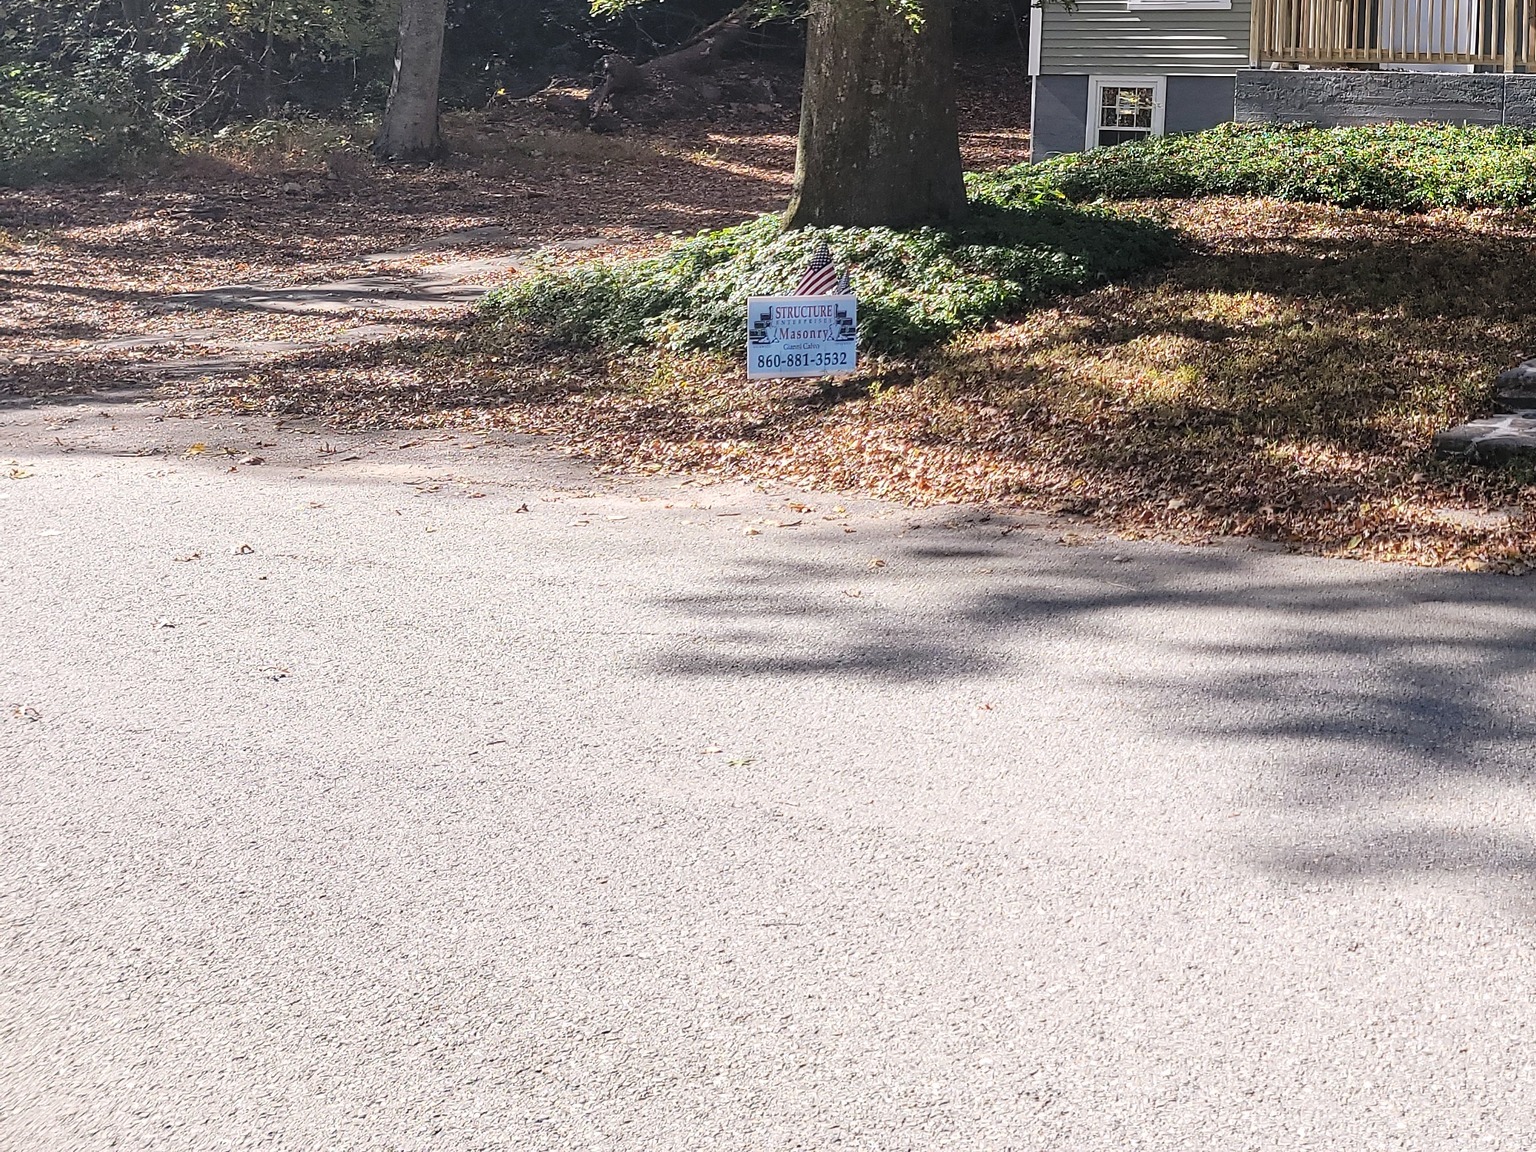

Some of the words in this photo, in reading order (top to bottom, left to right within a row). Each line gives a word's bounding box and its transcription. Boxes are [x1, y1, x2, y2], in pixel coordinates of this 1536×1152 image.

[775, 305, 833, 319] STRUCTURE
[779, 327, 829, 342] Masonry
[757, 352, 847, 368] 860-881-3532
